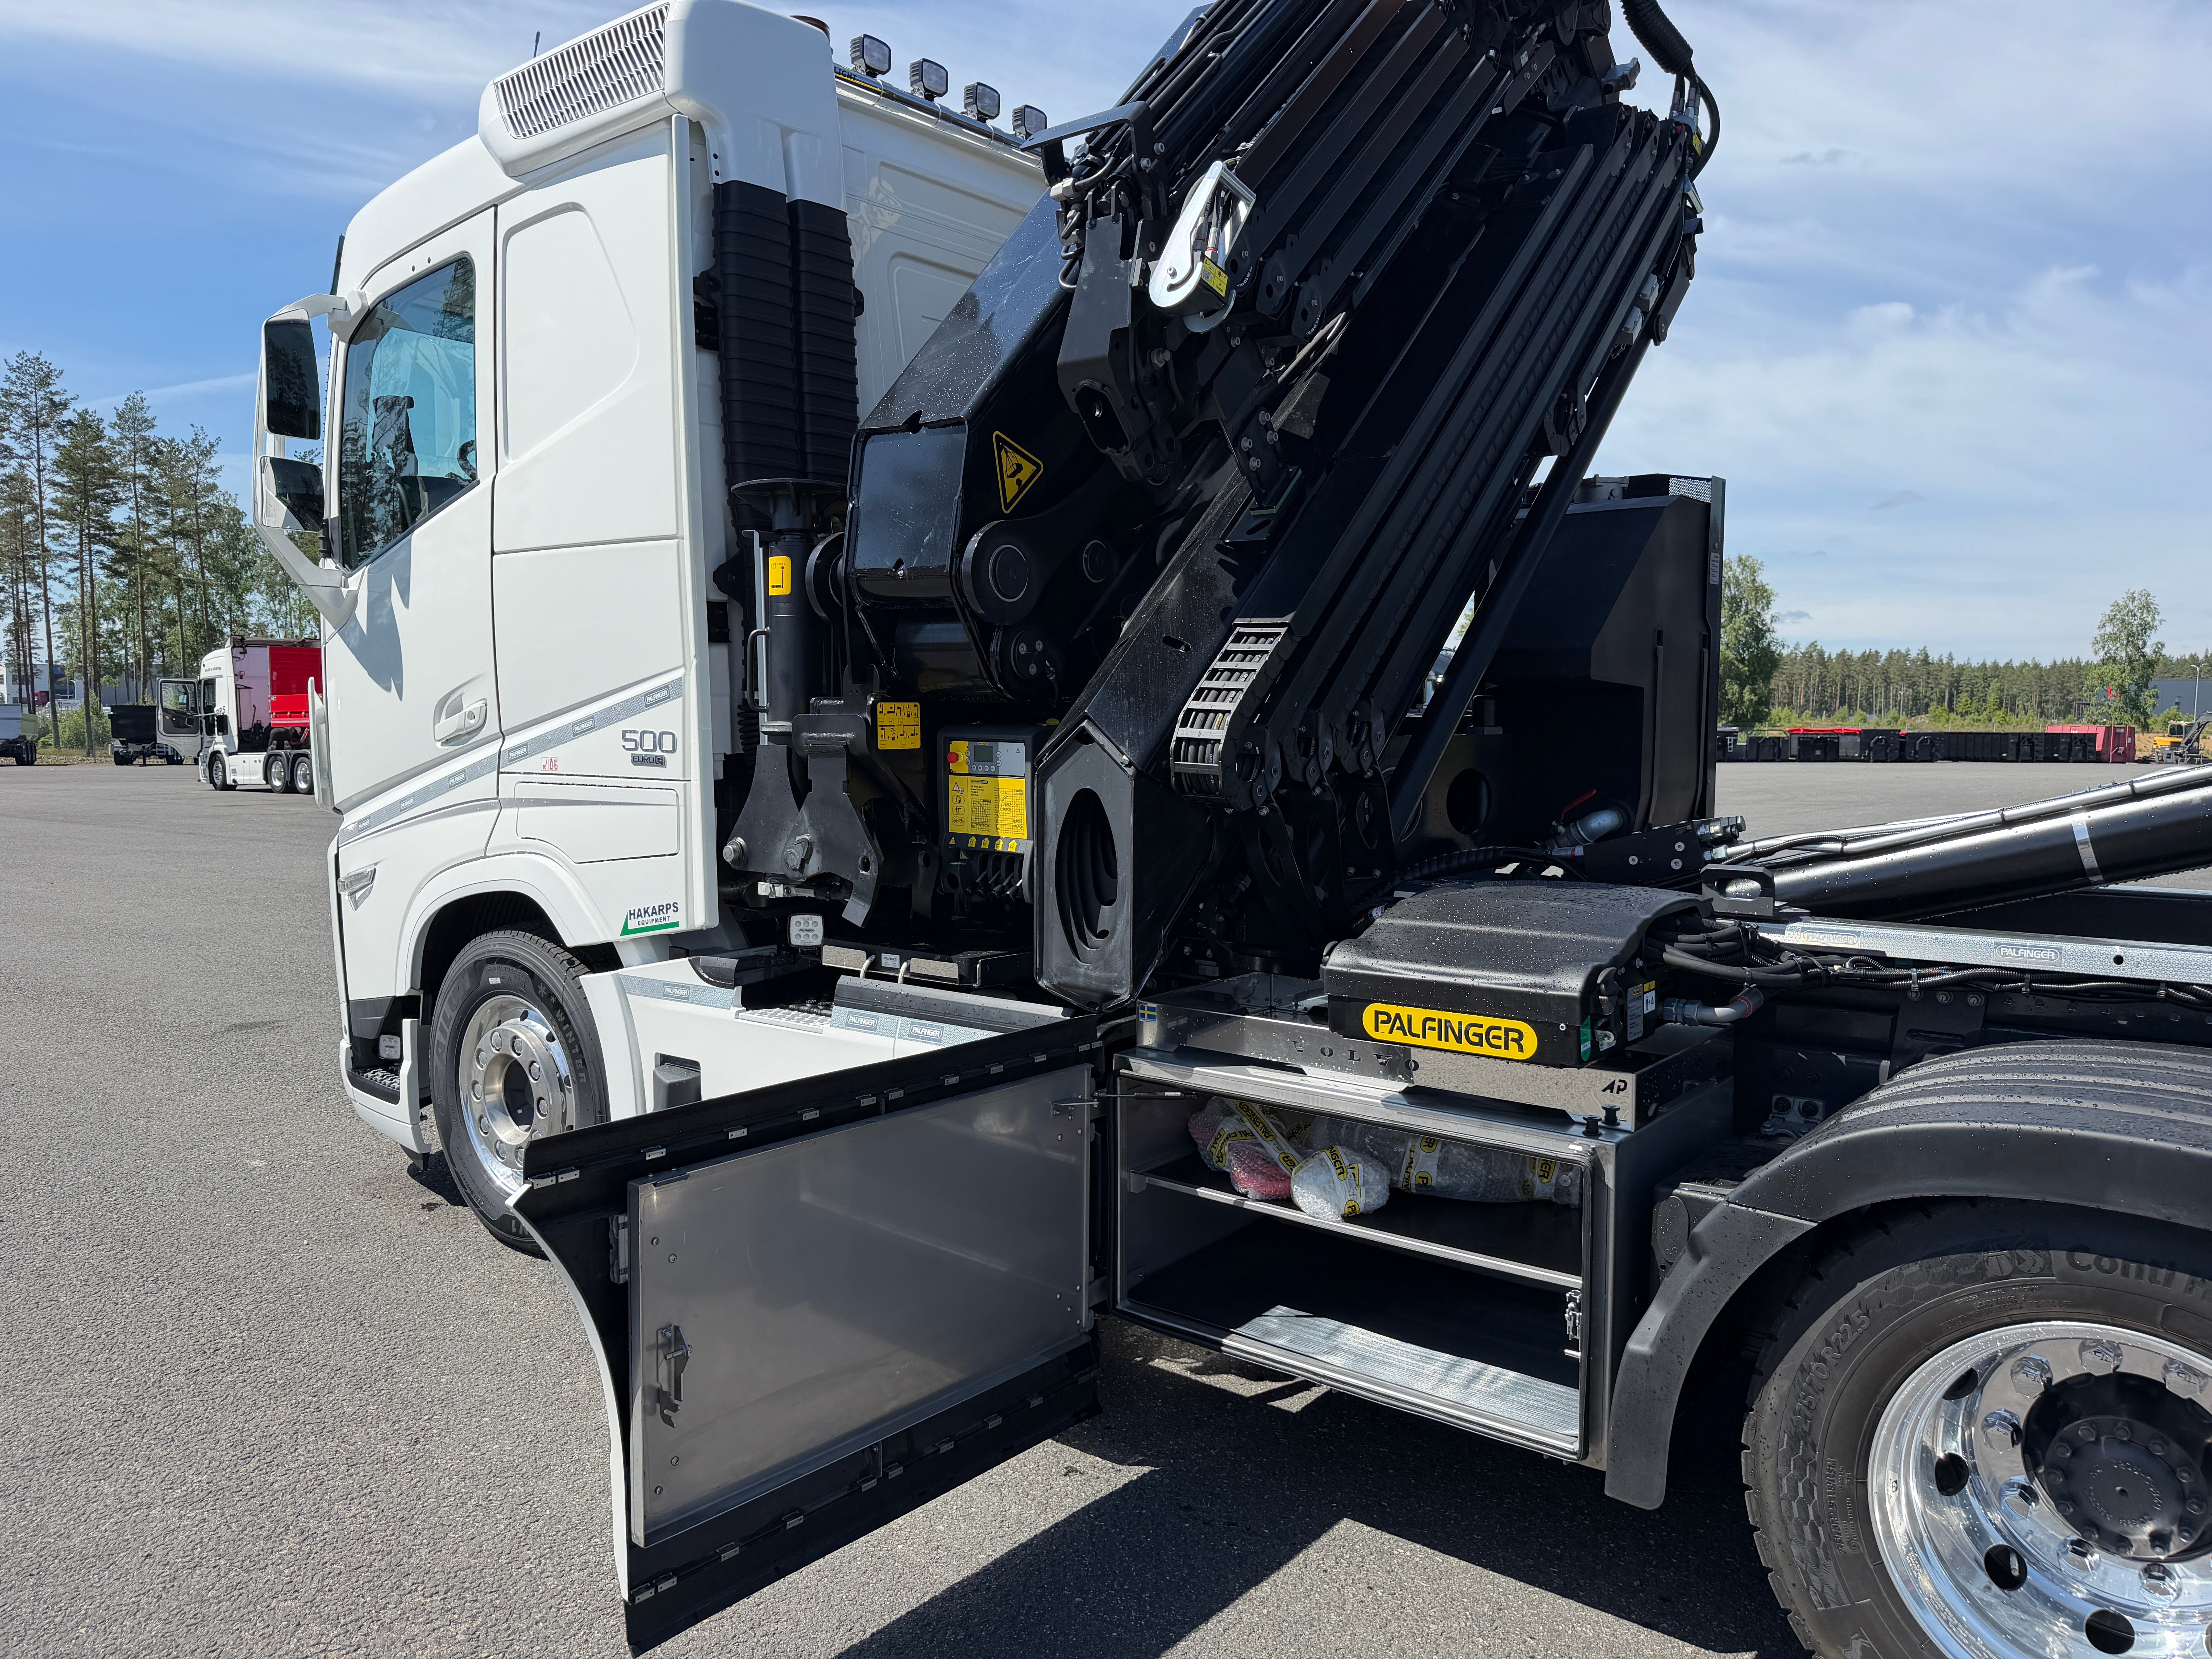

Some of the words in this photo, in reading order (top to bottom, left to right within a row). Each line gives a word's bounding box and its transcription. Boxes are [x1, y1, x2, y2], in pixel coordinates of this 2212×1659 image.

[646, 689, 668, 703] PALFINGER
[574, 720, 593, 732] PALFINGER
[622, 730, 677, 754] 500
[510, 747, 527, 759] PALFINGER
[633, 755, 654, 764] EURO
[450, 774, 465, 785] PALFINGER
[629, 902, 679, 920] HAKARPS
[638, 915, 670, 926] EQUIPMENT
[1805, 932, 1856, 944] PALFINGER
[2001, 948, 2056, 960] PALFINGER
[665, 987, 687, 996] PALFINGER
[849, 1016, 876, 1027] PALFINGER
[434, 972, 471, 1094] SAILUN
[912, 1026, 940, 1038] PALFINGER
[1374, 1010, 1525, 1053] PALFINGER
[555, 1009, 586, 1084] WINTER
[1291, 1039, 1420, 1072] VOLVO
[1239, 1102, 1272, 1140] PALFINGER
[1793, 1362, 1831, 1433] 275/70
[1820, 1309, 1871, 1367] R22.5
